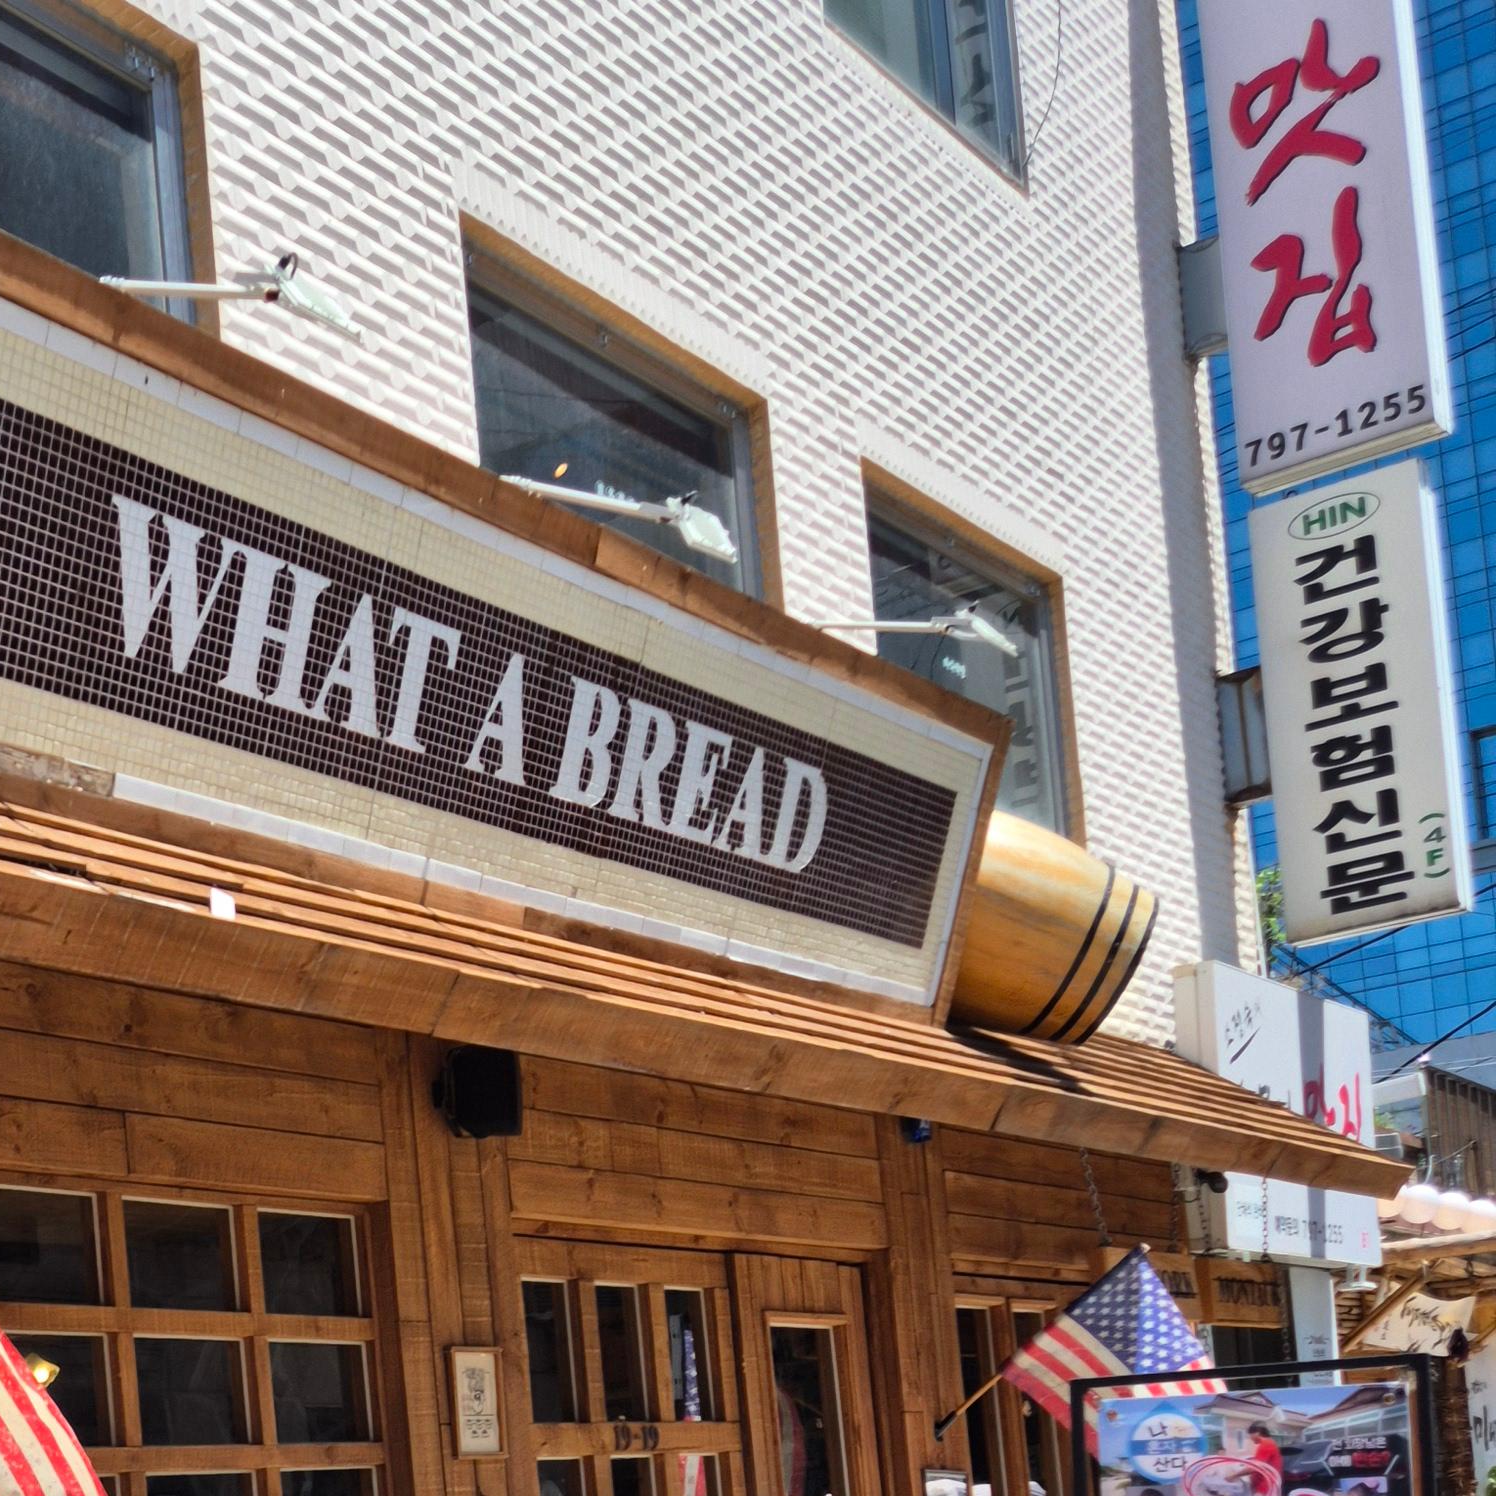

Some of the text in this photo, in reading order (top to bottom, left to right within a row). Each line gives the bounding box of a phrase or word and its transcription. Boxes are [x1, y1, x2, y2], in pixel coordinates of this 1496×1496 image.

[1229, 17, 1380, 367] 맛집
[1244, 384, 1428, 467] 797-1255
[1302, 496, 1367, 537] HIN
[112, 496, 461, 753] WHAT
[463, 653, 528, 786] A
[549, 676, 827, 873] BREAD
[1293, 533, 1415, 915] 건강보험신문
[1153, 1456, 1188, 1473] 산다
